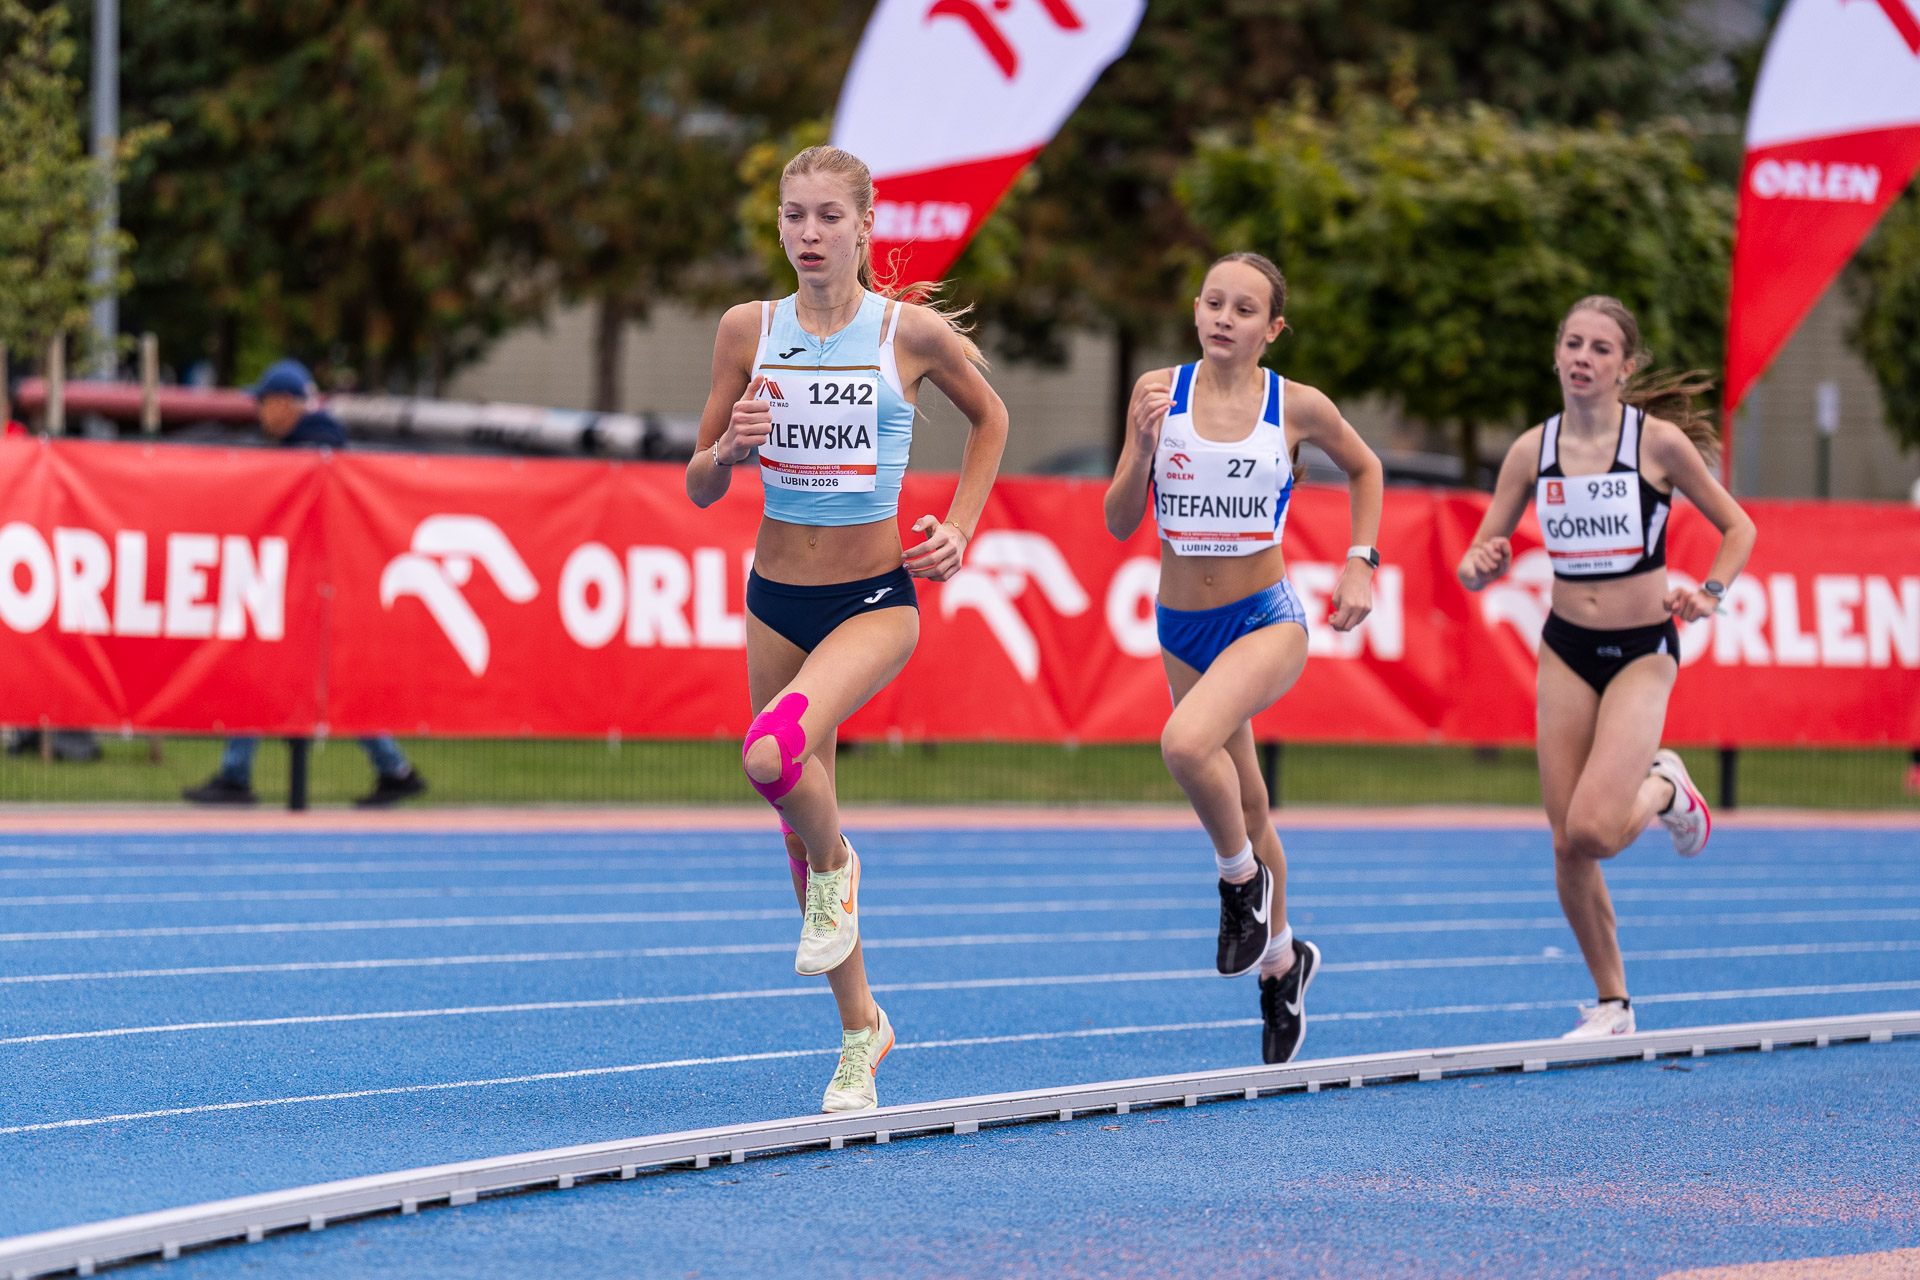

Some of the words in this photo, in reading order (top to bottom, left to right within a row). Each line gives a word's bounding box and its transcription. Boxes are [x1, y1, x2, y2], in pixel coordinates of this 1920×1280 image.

[1753, 158, 1881, 204] ORLEN
[872, 201, 972, 241] RLEN
[808, 382, 873, 405] 1242
[1166, 472, 1194, 480] ORLEN
[1227, 459, 1257, 478] 27
[781, 476, 809, 487] LUBIN
[811, 478, 839, 487] 2026
[1588, 479, 1627, 499] 938
[1161, 492, 1268, 518] STEFANIUK
[1547, 513, 1630, 538] GÓRNIK
[1181, 544, 1211, 552] LUBIN
[1213, 544, 1238, 552] 2026
[0, 521, 288, 641] ORLEN
[558, 541, 755, 649] ORL
[1106, 556, 1404, 661] OEN
